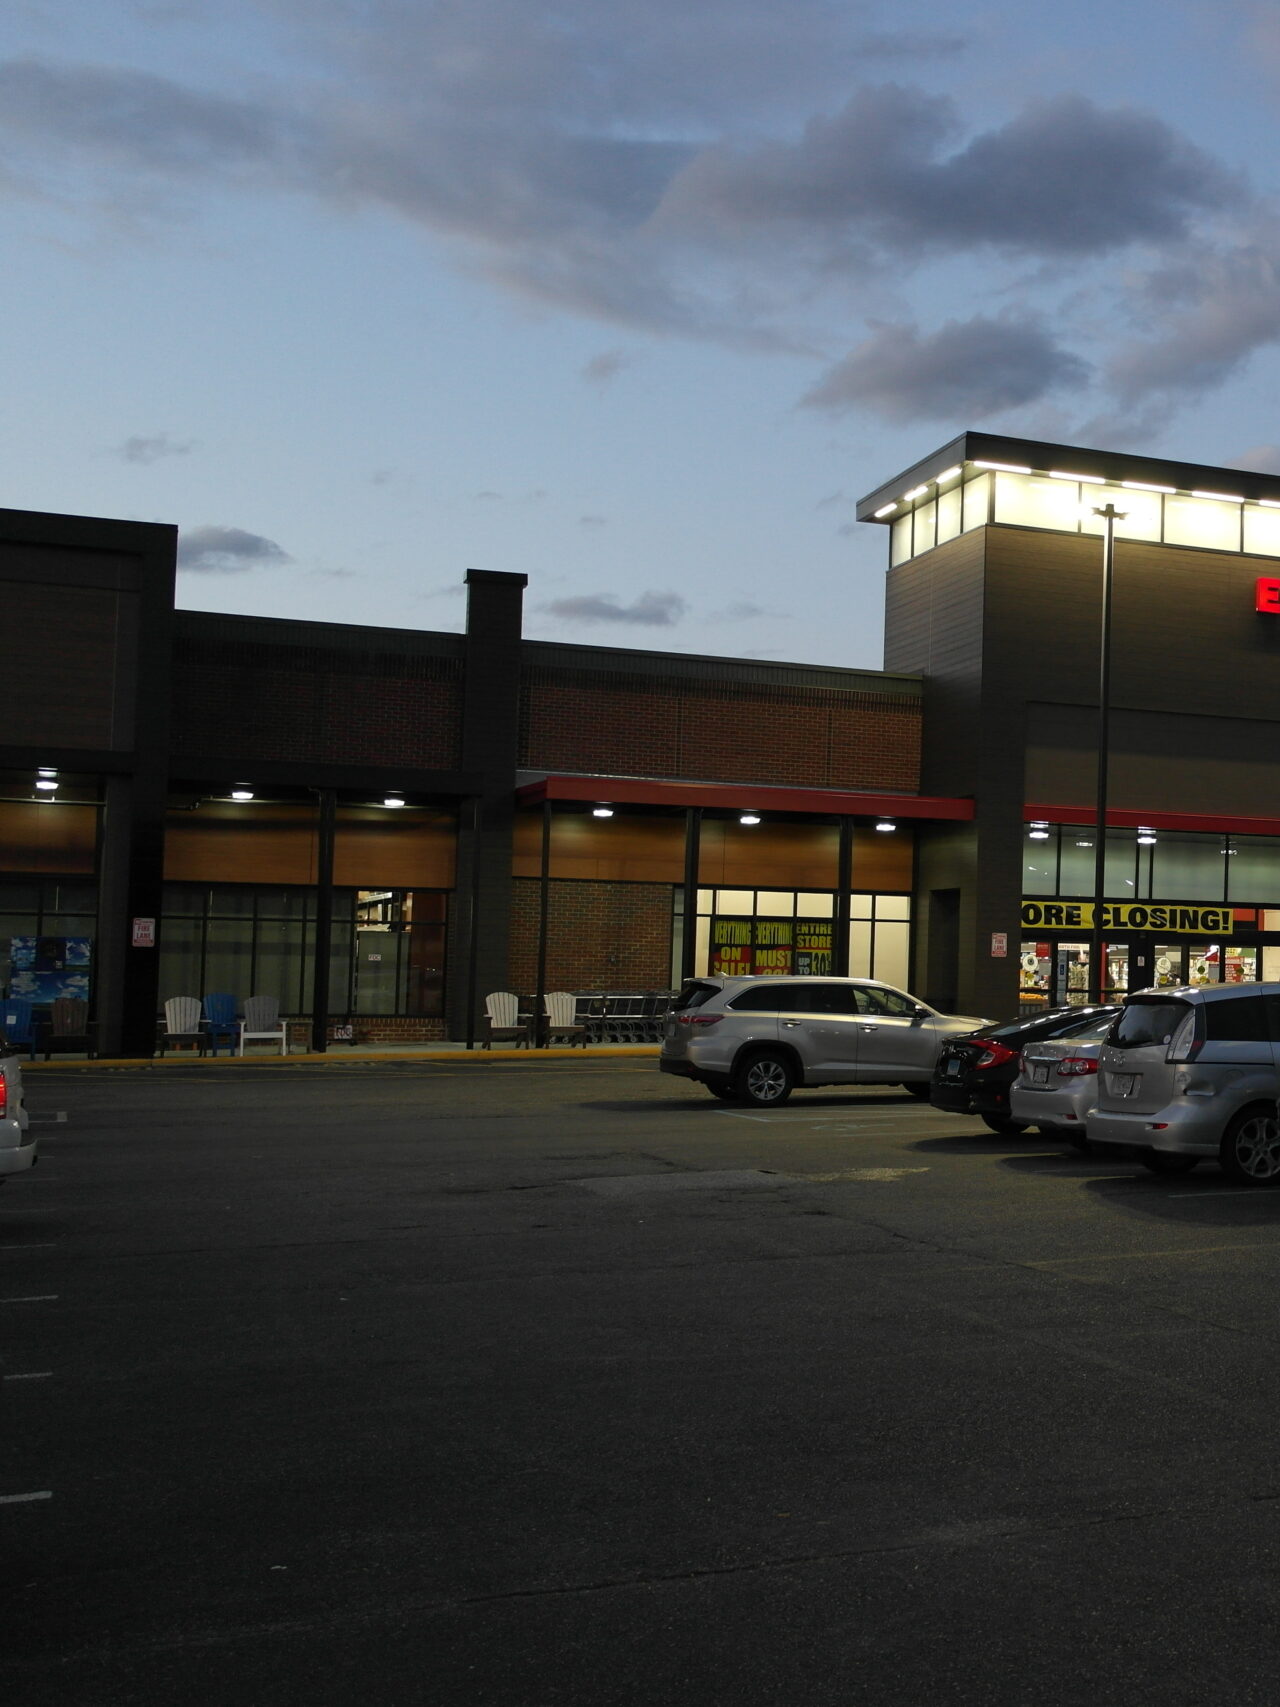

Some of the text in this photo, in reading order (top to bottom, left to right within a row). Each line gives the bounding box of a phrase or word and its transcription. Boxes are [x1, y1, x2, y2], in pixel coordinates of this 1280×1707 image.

[1021, 903, 1230, 931] ORE CLOSING!
[796, 923, 833, 935] ENTIRE
[797, 935, 833, 948] STORE
[720, 946, 742, 960] ON
[755, 949, 792, 967] MUST
